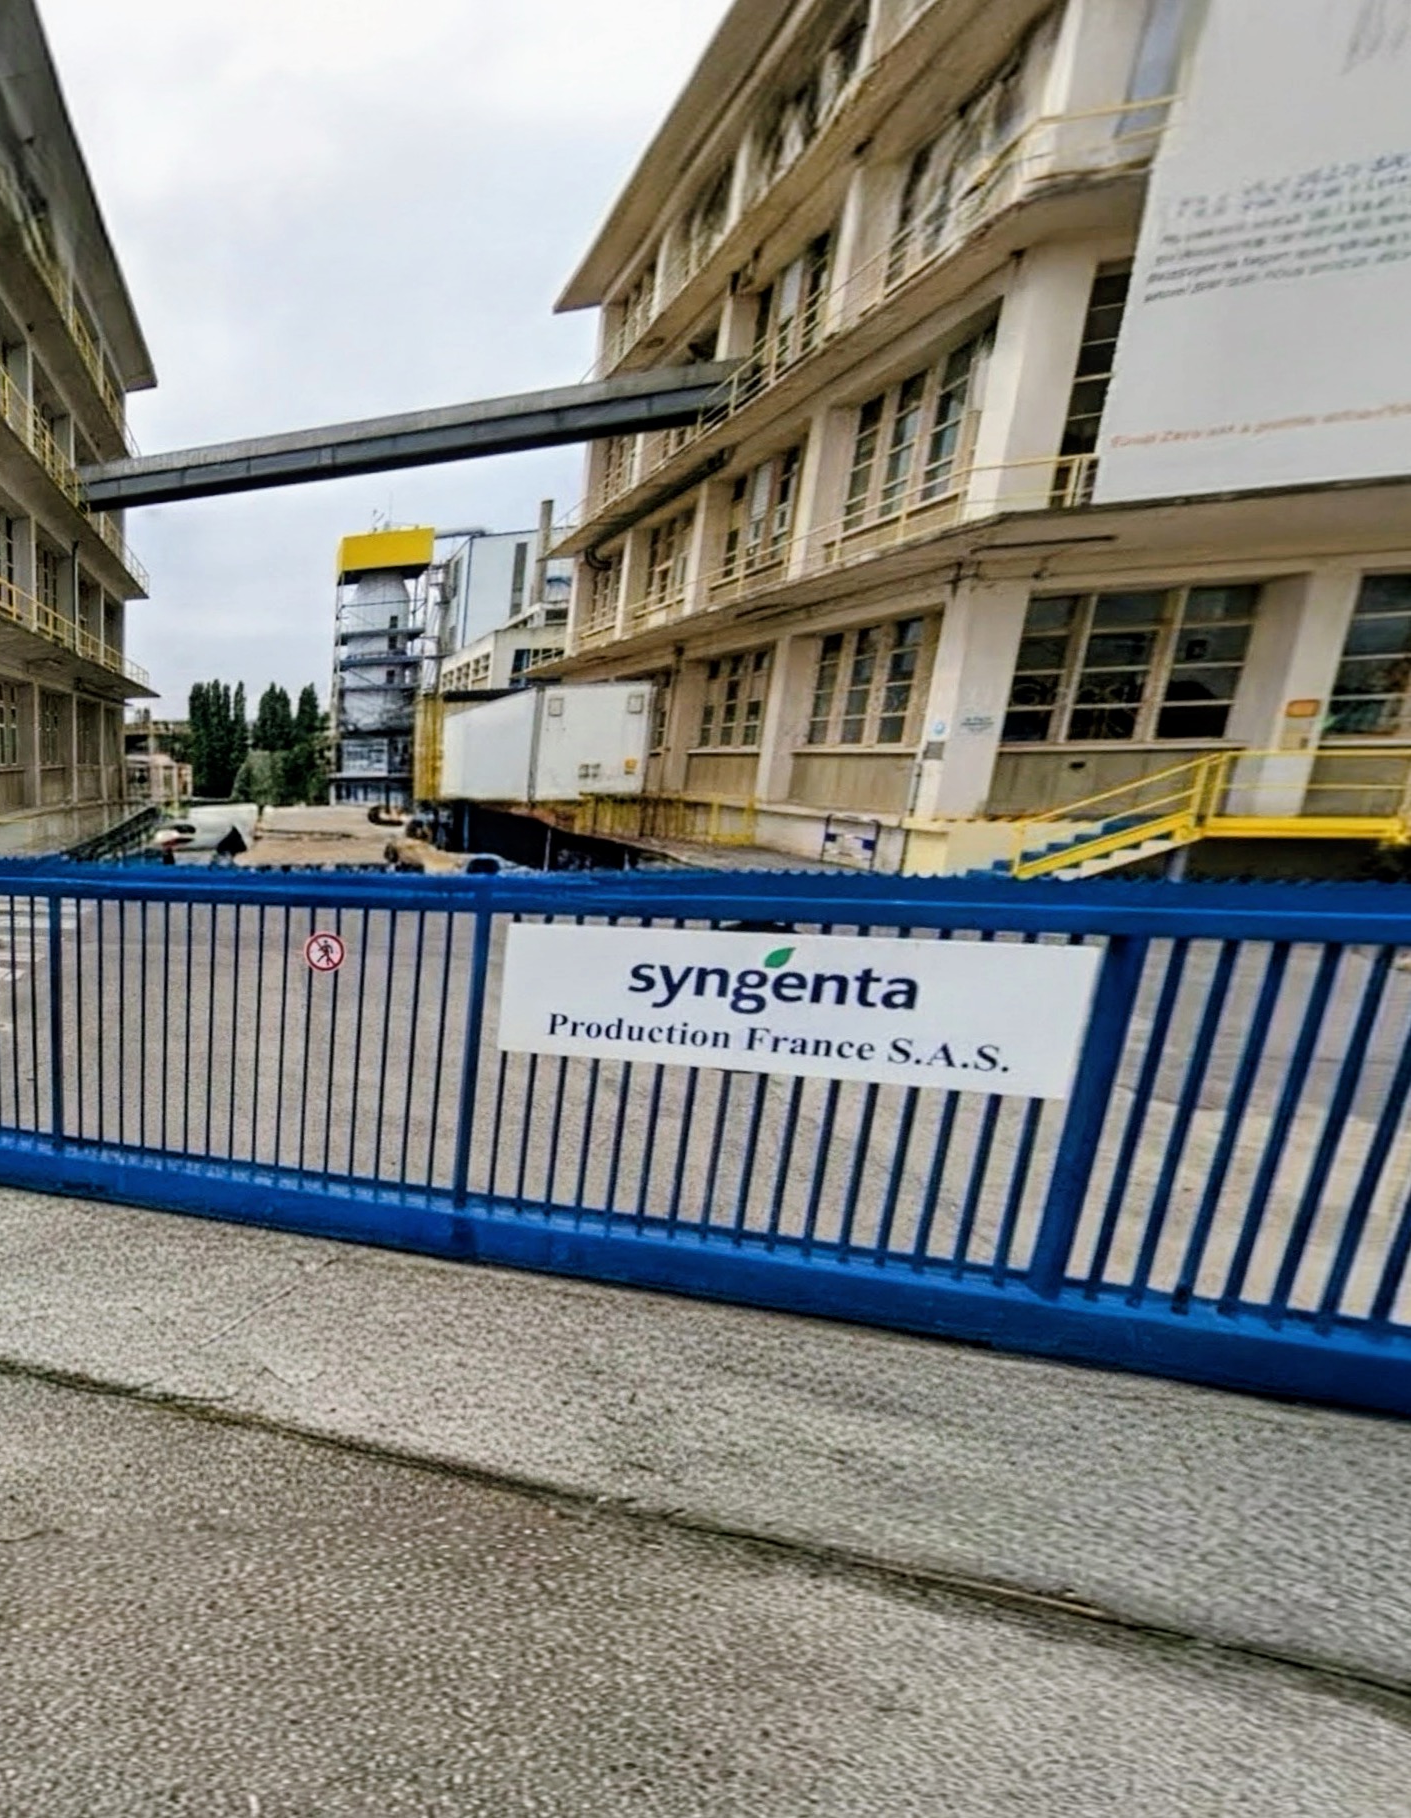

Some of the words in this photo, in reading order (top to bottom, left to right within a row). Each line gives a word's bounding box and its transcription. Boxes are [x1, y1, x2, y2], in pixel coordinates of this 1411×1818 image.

[628, 963, 919, 1014] syngenta
[547, 1013, 731, 1049] Production
[746, 1027, 876, 1061] France
[887, 1037, 1010, 1073] S.A.S.
